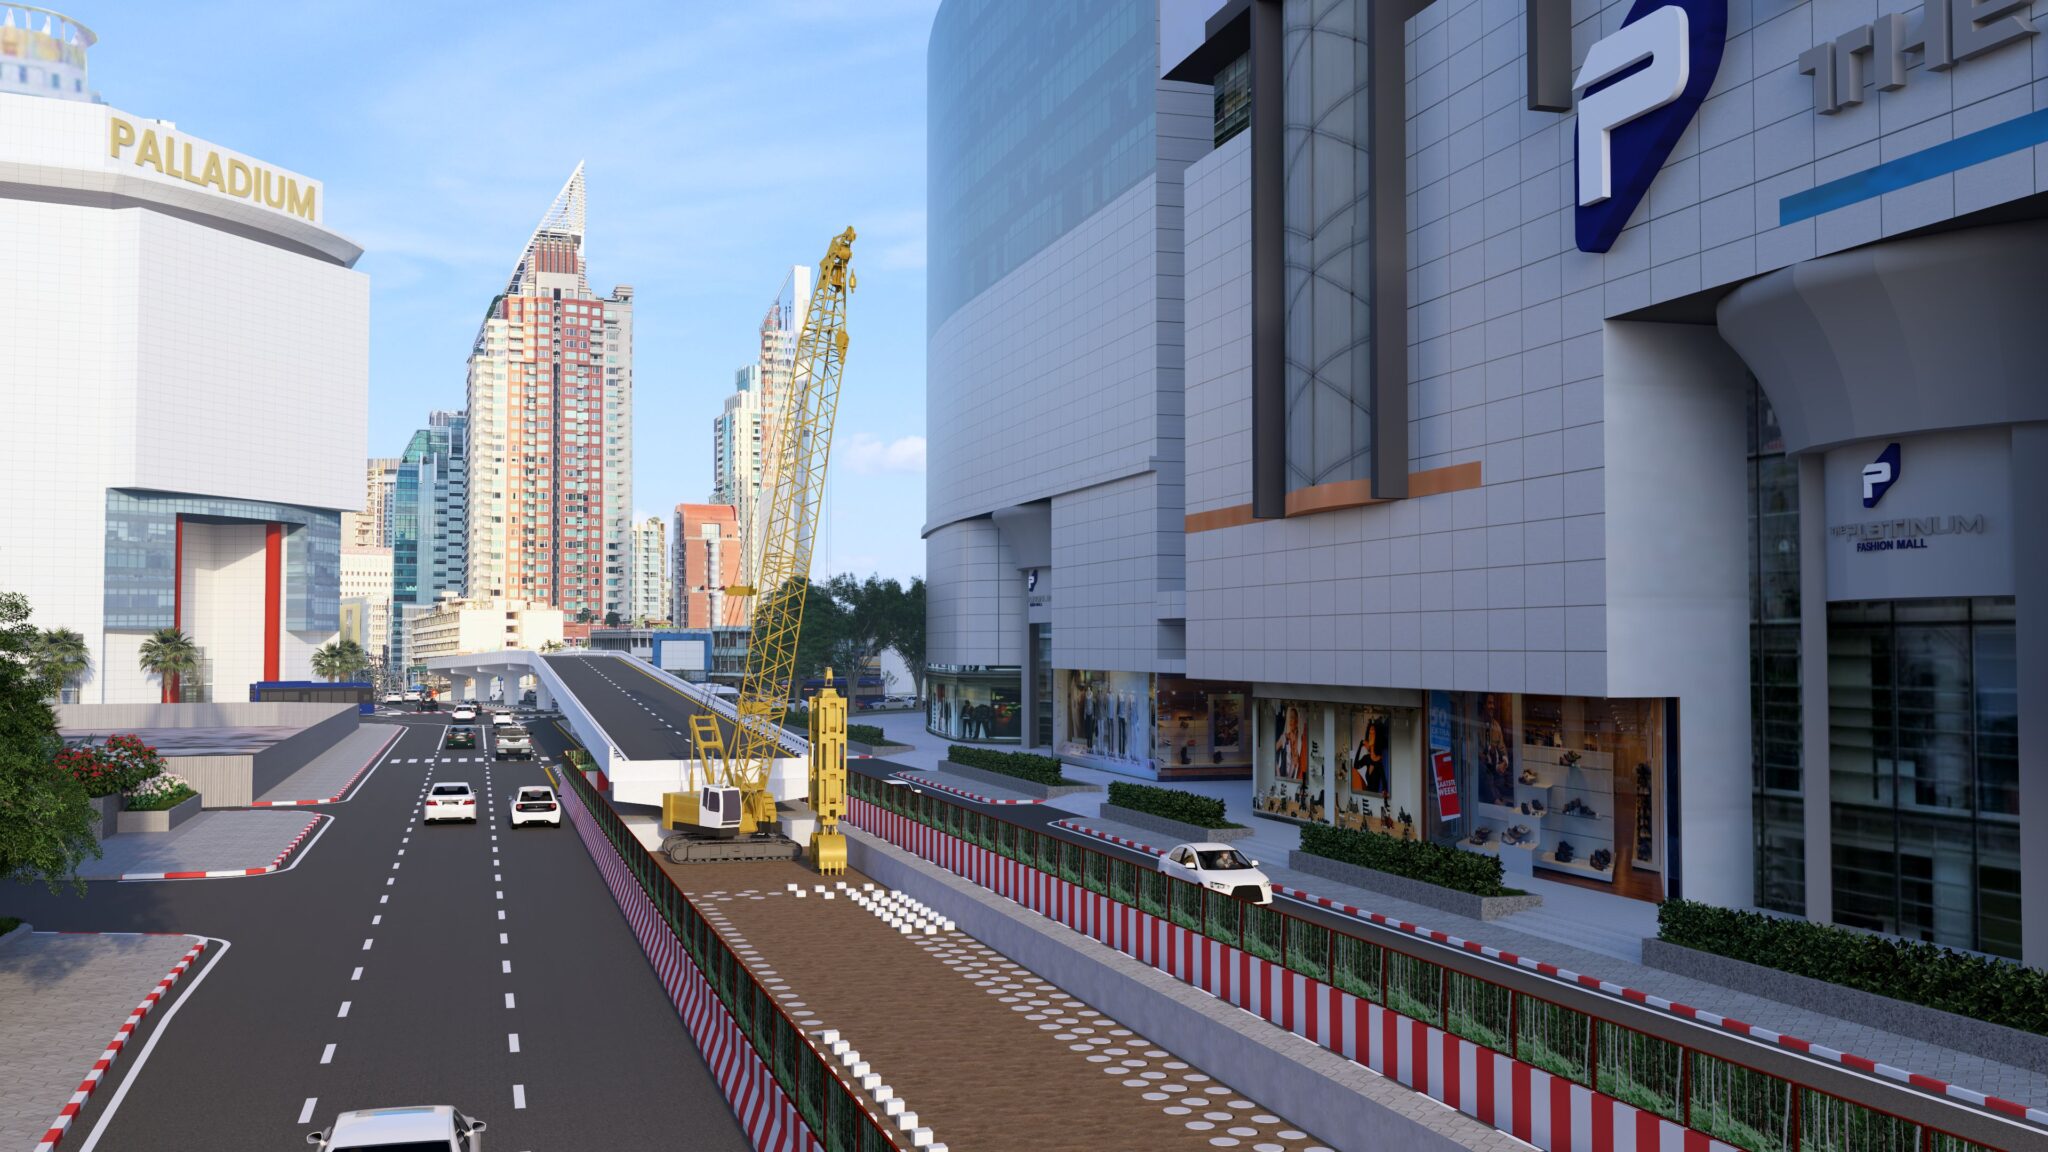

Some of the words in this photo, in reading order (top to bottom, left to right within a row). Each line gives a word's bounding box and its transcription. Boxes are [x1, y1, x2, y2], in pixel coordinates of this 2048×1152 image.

[1572, 4, 1690, 207] P
[1798, 0, 2040, 116] THE
[110, 117, 316, 222] PALLADIUM
[1862, 461, 1892, 499] P
[1856, 539, 1894, 552] FASHION
[1896, 538, 1928, 550] MALL
